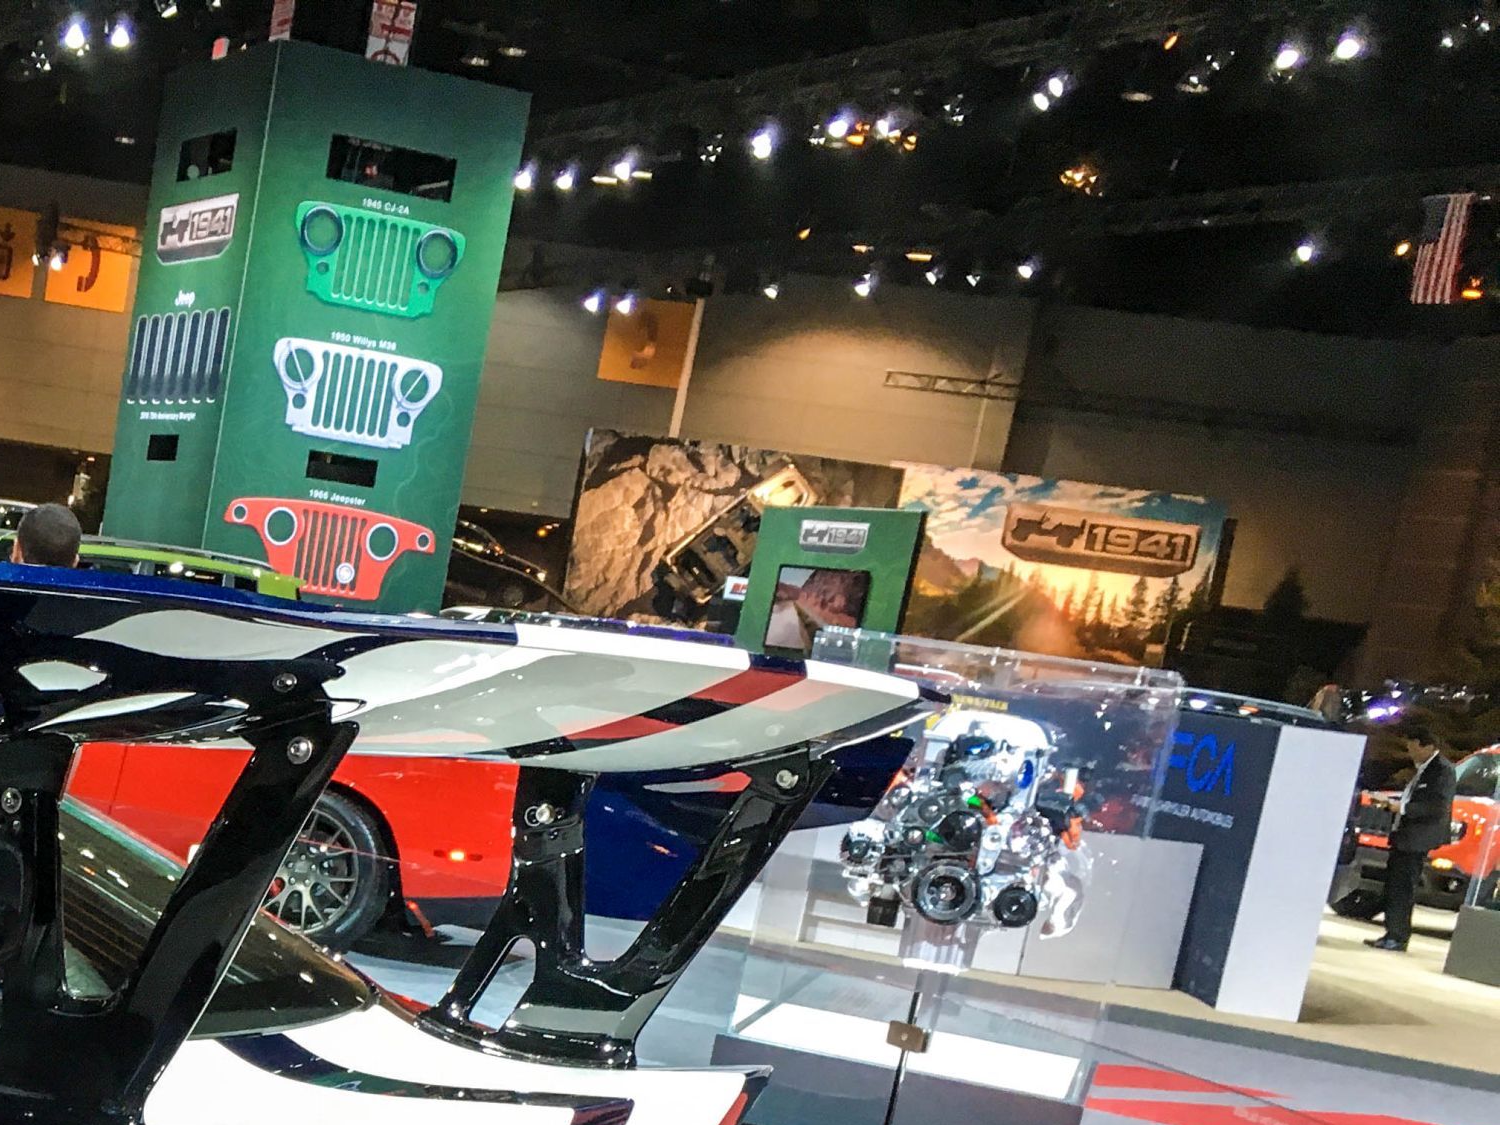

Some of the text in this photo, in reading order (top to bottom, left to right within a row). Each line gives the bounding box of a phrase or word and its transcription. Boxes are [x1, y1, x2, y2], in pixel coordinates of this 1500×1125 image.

[191, 206, 232, 241] 1941
[174, 289, 196, 308] Jeep
[1088, 524, 1188, 561] 1941
